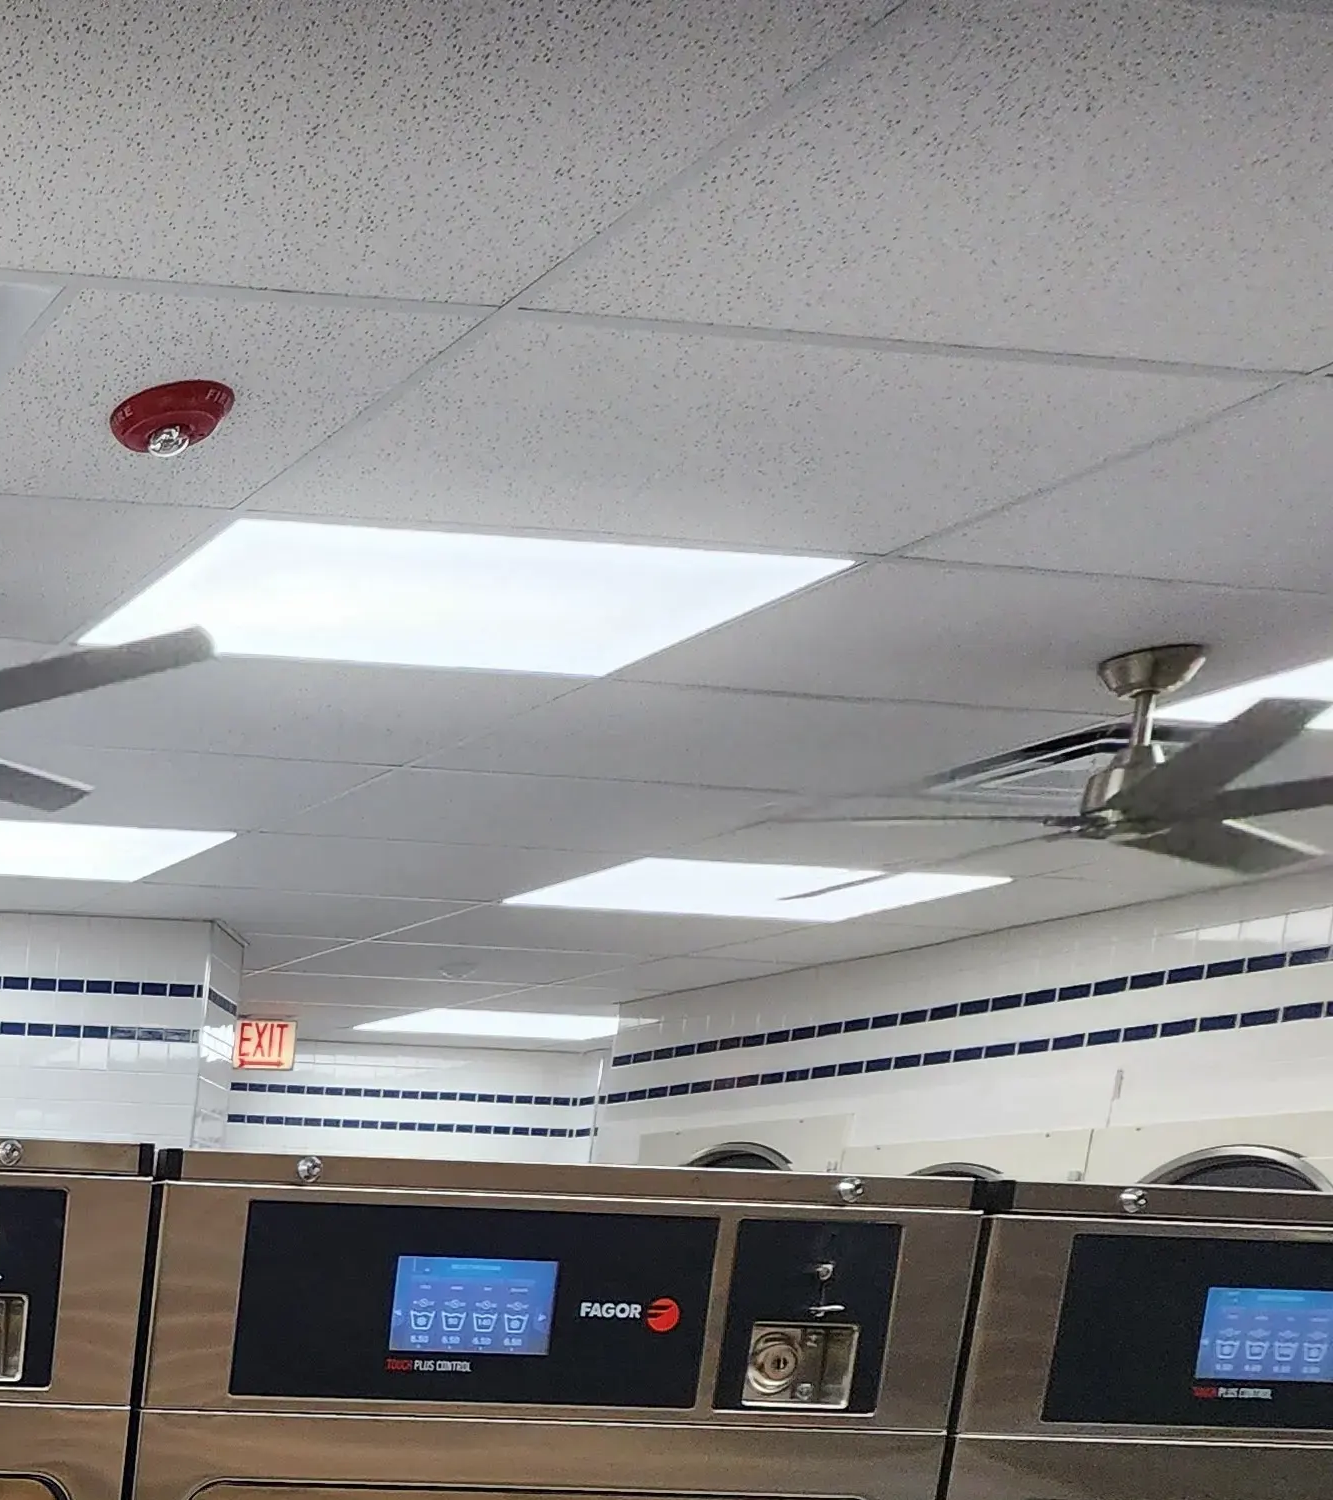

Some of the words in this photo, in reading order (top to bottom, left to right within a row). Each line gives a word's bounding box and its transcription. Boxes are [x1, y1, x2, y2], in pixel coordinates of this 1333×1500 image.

[239, 1022, 289, 1058] EXIT
[580, 1302, 642, 1319] FAGOR
[414, 1359, 435, 1371] PLUS
